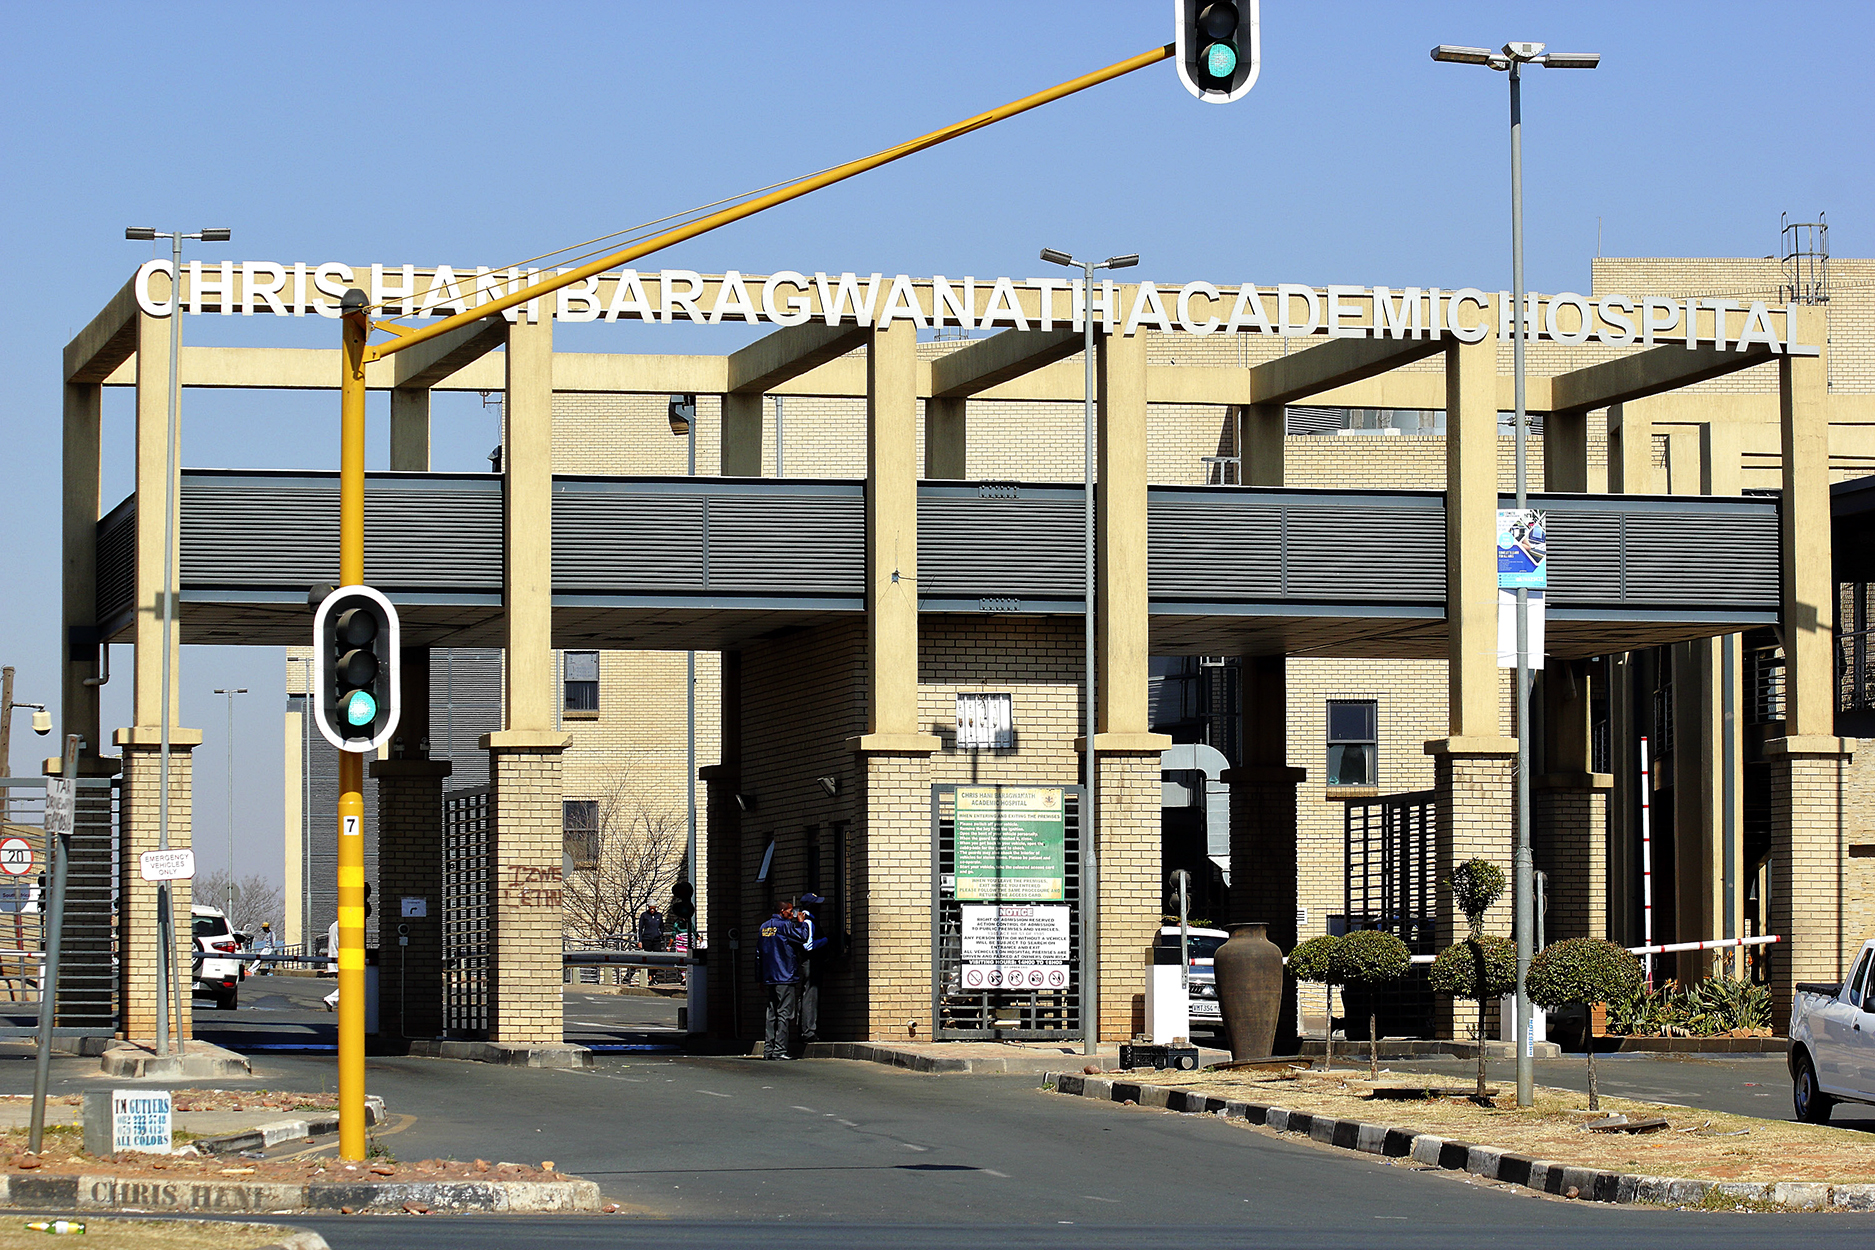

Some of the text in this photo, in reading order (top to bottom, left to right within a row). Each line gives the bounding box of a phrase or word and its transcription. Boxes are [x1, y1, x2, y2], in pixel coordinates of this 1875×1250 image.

[135, 259, 1820, 355] CHRIS HANI BARAGWANATH ACADEMIC HOSPITAL
[346, 818, 355, 833] 7
[8, 850, 24, 863] 20
[145, 854, 189, 862] EMERGENCY
[150, 861, 185, 869] VEHICLES
[999, 908, 1033, 917] NOTICE
[130, 1098, 169, 1114] GUTTERS
[116, 1135, 168, 1146] ALL COLORS
[90, 1181, 178, 1206] CHRIS
